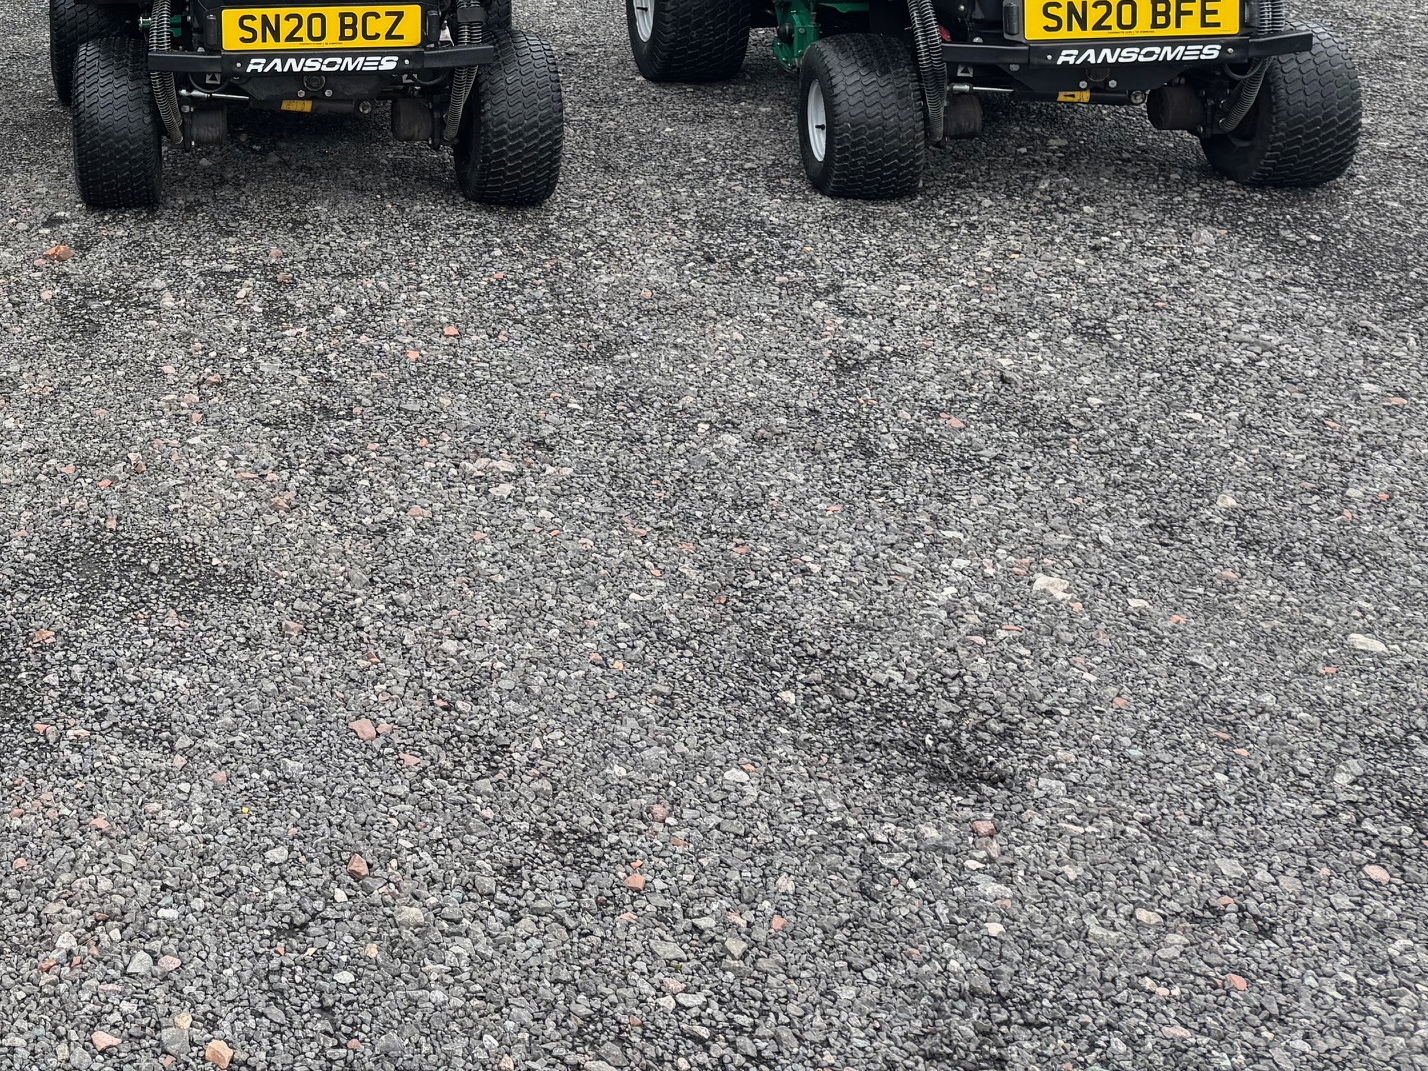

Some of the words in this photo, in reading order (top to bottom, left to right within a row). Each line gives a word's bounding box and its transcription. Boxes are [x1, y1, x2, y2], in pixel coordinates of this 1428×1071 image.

[238, 12, 327, 43] SN20
[338, 10, 405, 41] BCZ
[1042, 0, 1138, 32] SN20
[246, 56, 399, 73] RANSOMES
[1056, 44, 1222, 65] RANSOMES
